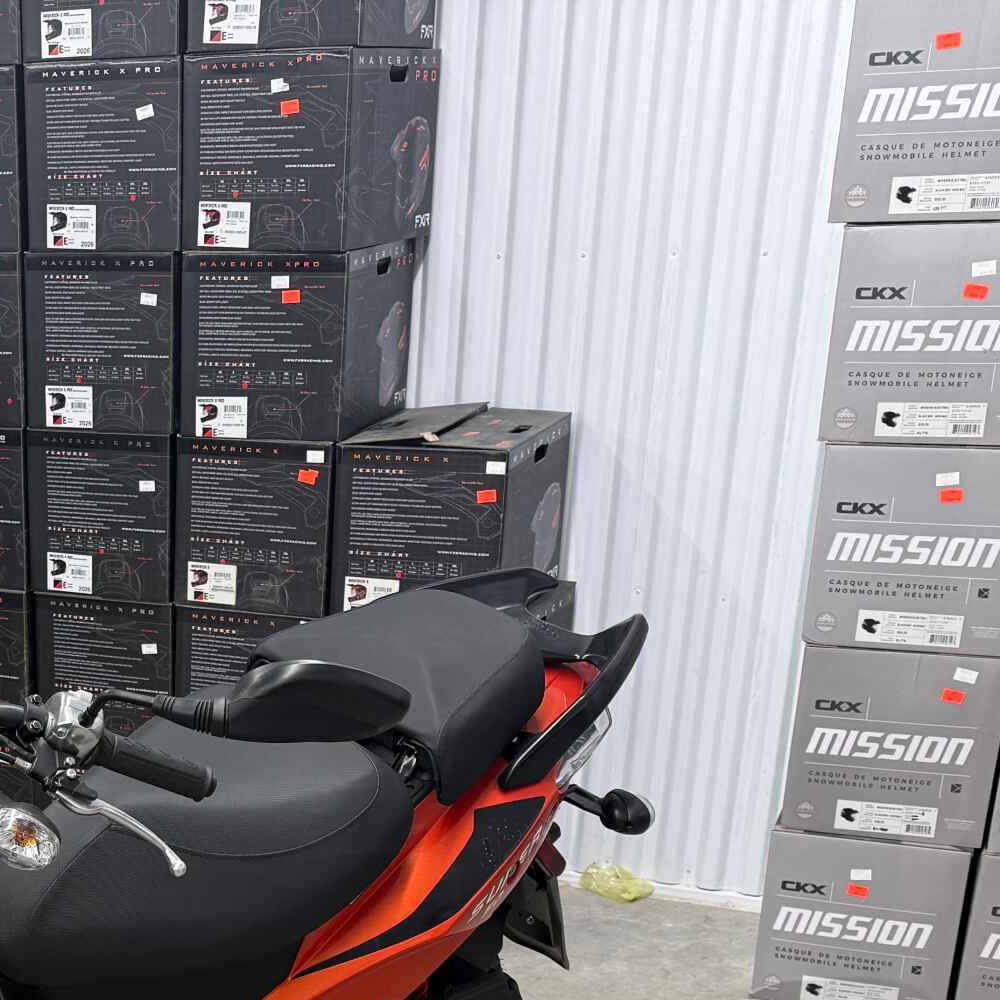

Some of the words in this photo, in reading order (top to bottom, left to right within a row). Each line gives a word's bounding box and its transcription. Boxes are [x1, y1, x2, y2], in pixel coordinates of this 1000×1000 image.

[869, 50, 924, 66] CKX
[201, 61, 276, 71] MAVERICK
[43, 69, 110, 77] MAVERICK
[415, 70, 437, 80] PRO
[861, 143, 905, 151] CASQUE
[934, 140, 1000, 149] MOTONEIGE
[860, 152, 934, 161] SNOWMOBILE
[942, 150, 987, 158] HELMET
[855, 287, 908, 300] CKX
[192, 444, 262, 454] MAVERICK
[353, 453, 431, 463] MAVERICK
[836, 502, 887, 515] CKX
[826, 532, 1000, 568] MISSION
[828, 587, 897, 597] SNOWMOBILE
[829, 579, 869, 587] CASQUE
[897, 583, 959, 592] MOTONEIGE
[815, 700, 863, 713] CKX
[805, 727, 975, 766] MISSION
[808, 770, 848, 780] CASQUE
[873, 776, 933, 787] MOTONEIGE
[808, 778, 874, 789] SNOWMOBILE
[781, 880, 826, 895] CKX
[773, 906, 934, 949] MISSION
[775, 946, 812, 956] CASQUE
[837, 954, 893, 967] MOTONEIGE
[844, 963, 881, 972] HELMET
